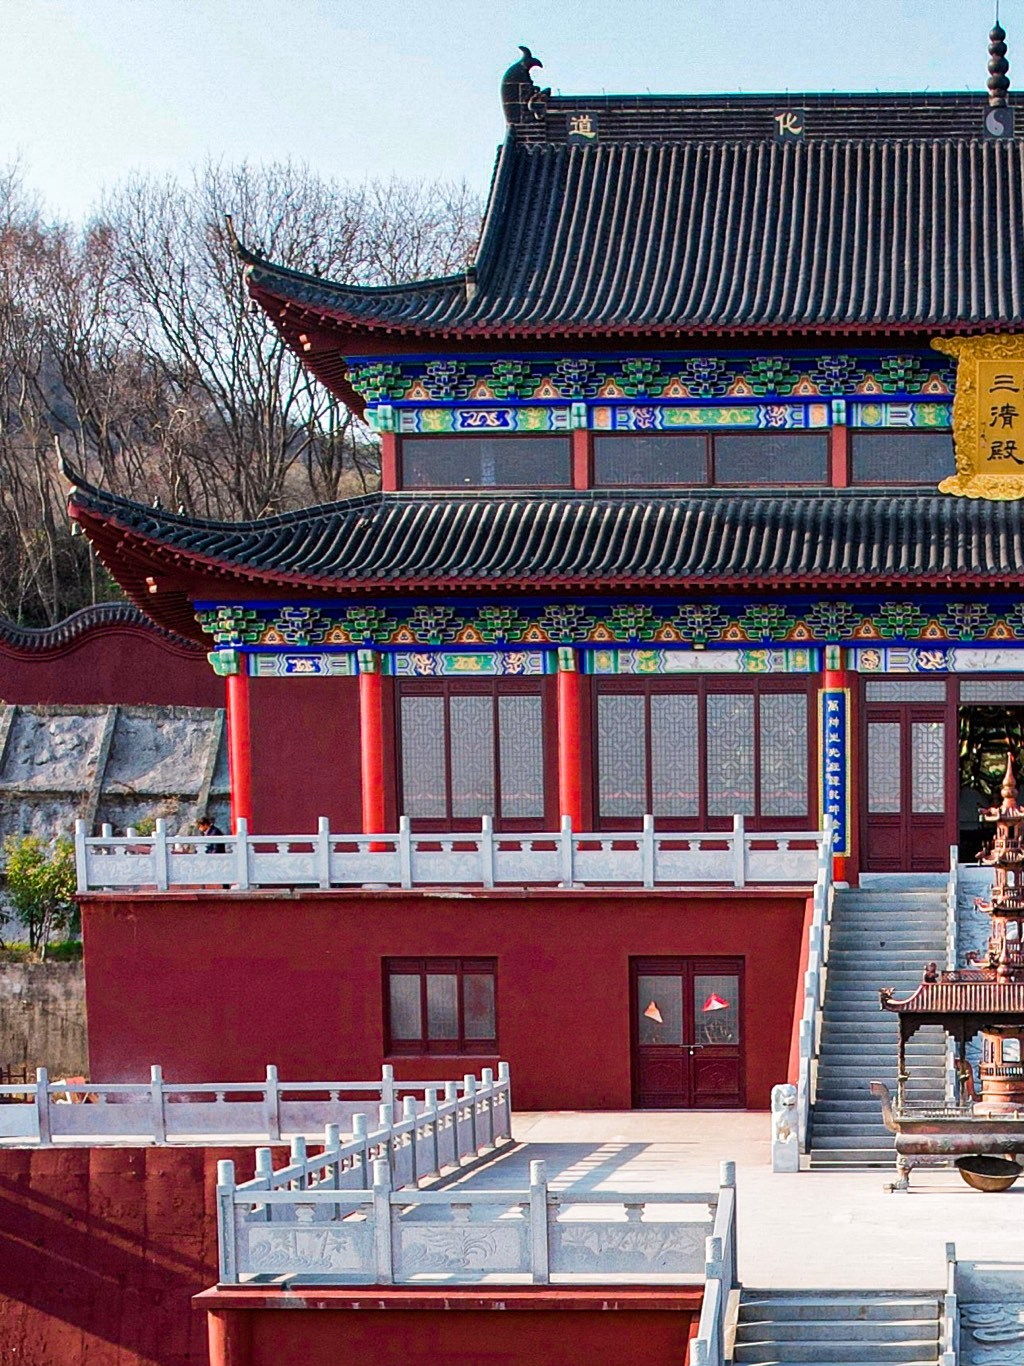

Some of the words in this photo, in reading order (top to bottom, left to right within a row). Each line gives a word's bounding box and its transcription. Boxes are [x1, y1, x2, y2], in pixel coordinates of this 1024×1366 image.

[568, 116, 596, 139] 道
[774, 113, 803, 136] 化
[987, 374, 1024, 465] 三清殿
